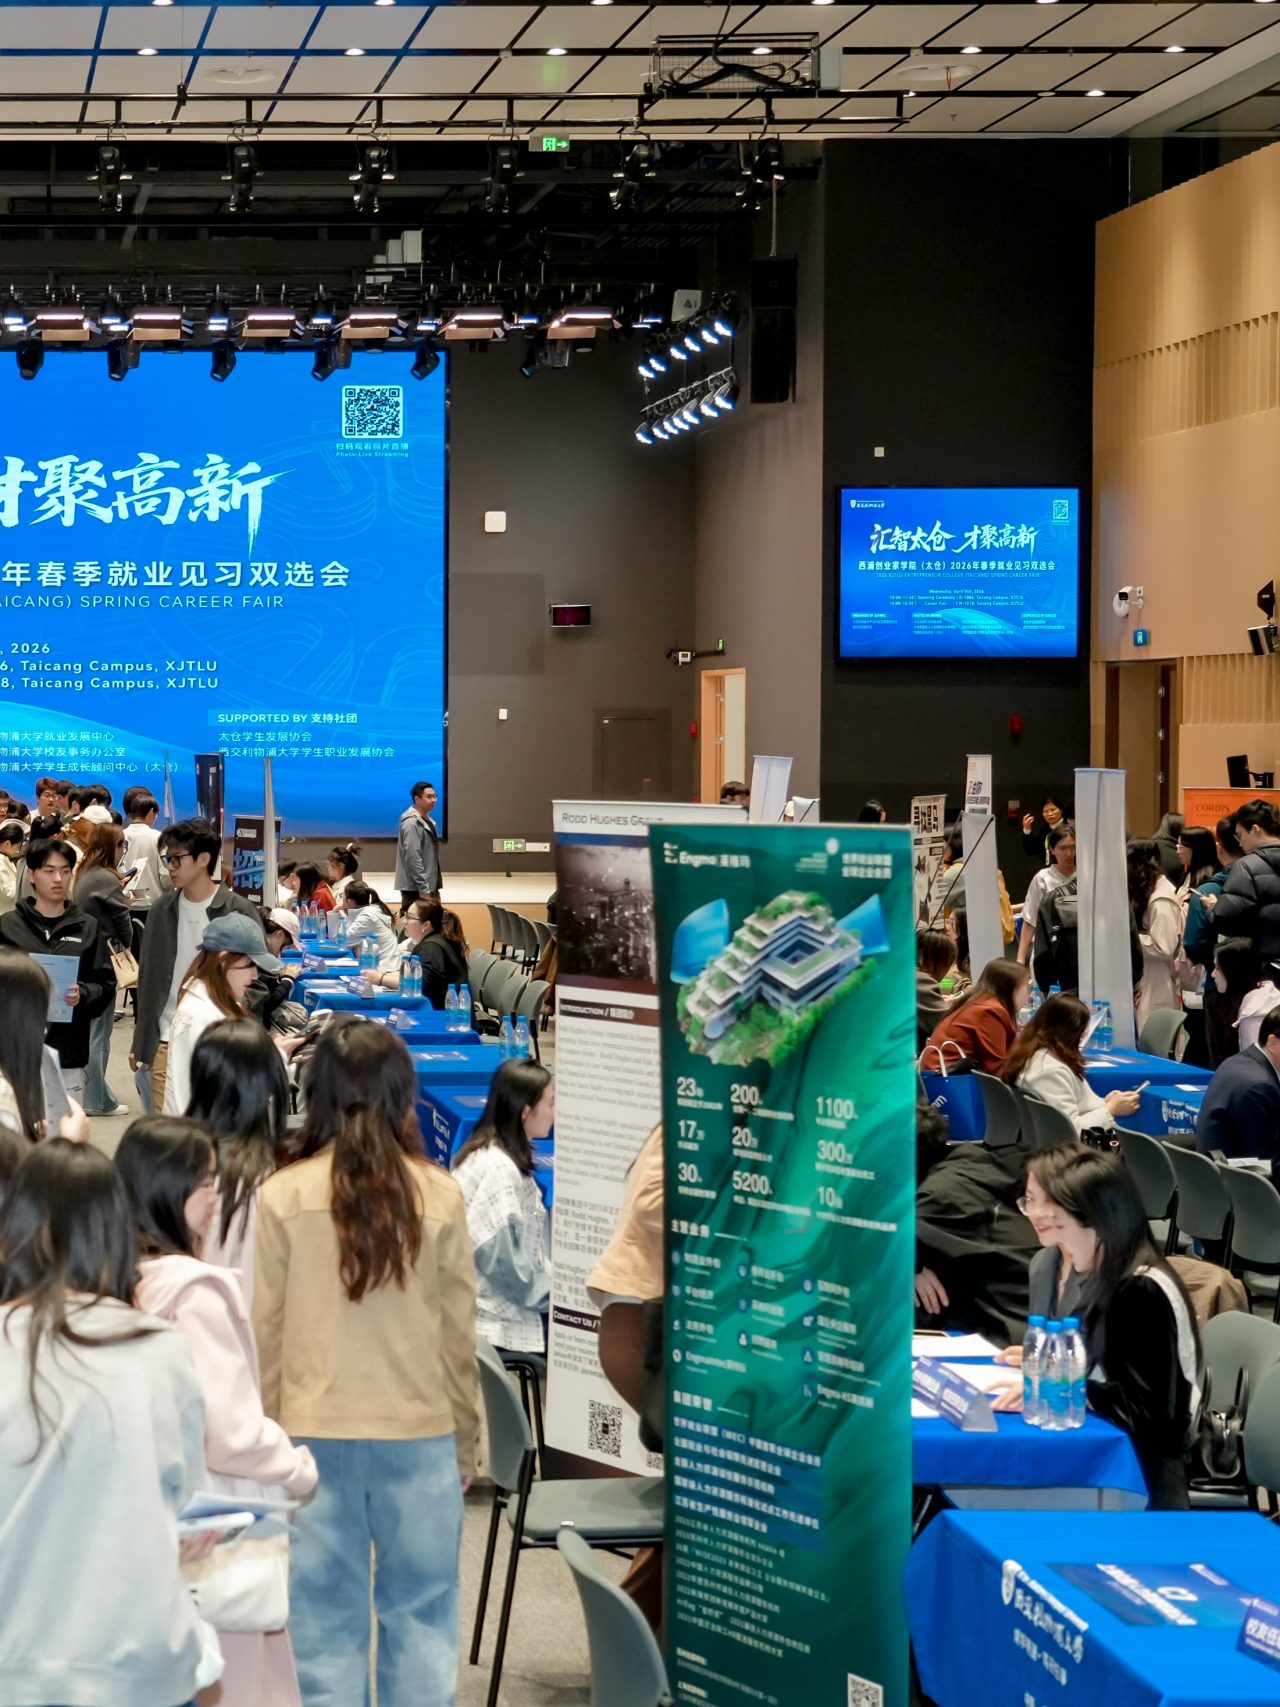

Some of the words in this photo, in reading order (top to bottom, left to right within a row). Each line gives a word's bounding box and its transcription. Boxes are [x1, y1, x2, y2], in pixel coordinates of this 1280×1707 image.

[870, 520, 956, 554] 汇智太仓
[951, 523, 1042, 559] 才聚高新
[80, 595, 150, 608] SPRING
[159, 595, 233, 608] CAREER
[242, 595, 283, 608] FAIR
[11, 643, 50, 656] 2026
[20, 660, 82, 673] Taicang
[89, 660, 158, 673] Campus,
[165, 660, 217, 673] XJTLU
[21, 677, 83, 690] Taicang
[90, 677, 159, 690] Campus,
[167, 677, 218, 690] XJTLU
[218, 714, 290, 723] SUPPORTED
[292, 714, 307, 723] BY
[311, 713, 357, 724] 支持社团
[218, 731, 312, 742] 太仓学生发展协会
[218, 747, 395, 757] 西交利物浦大学学生职业发展协会
